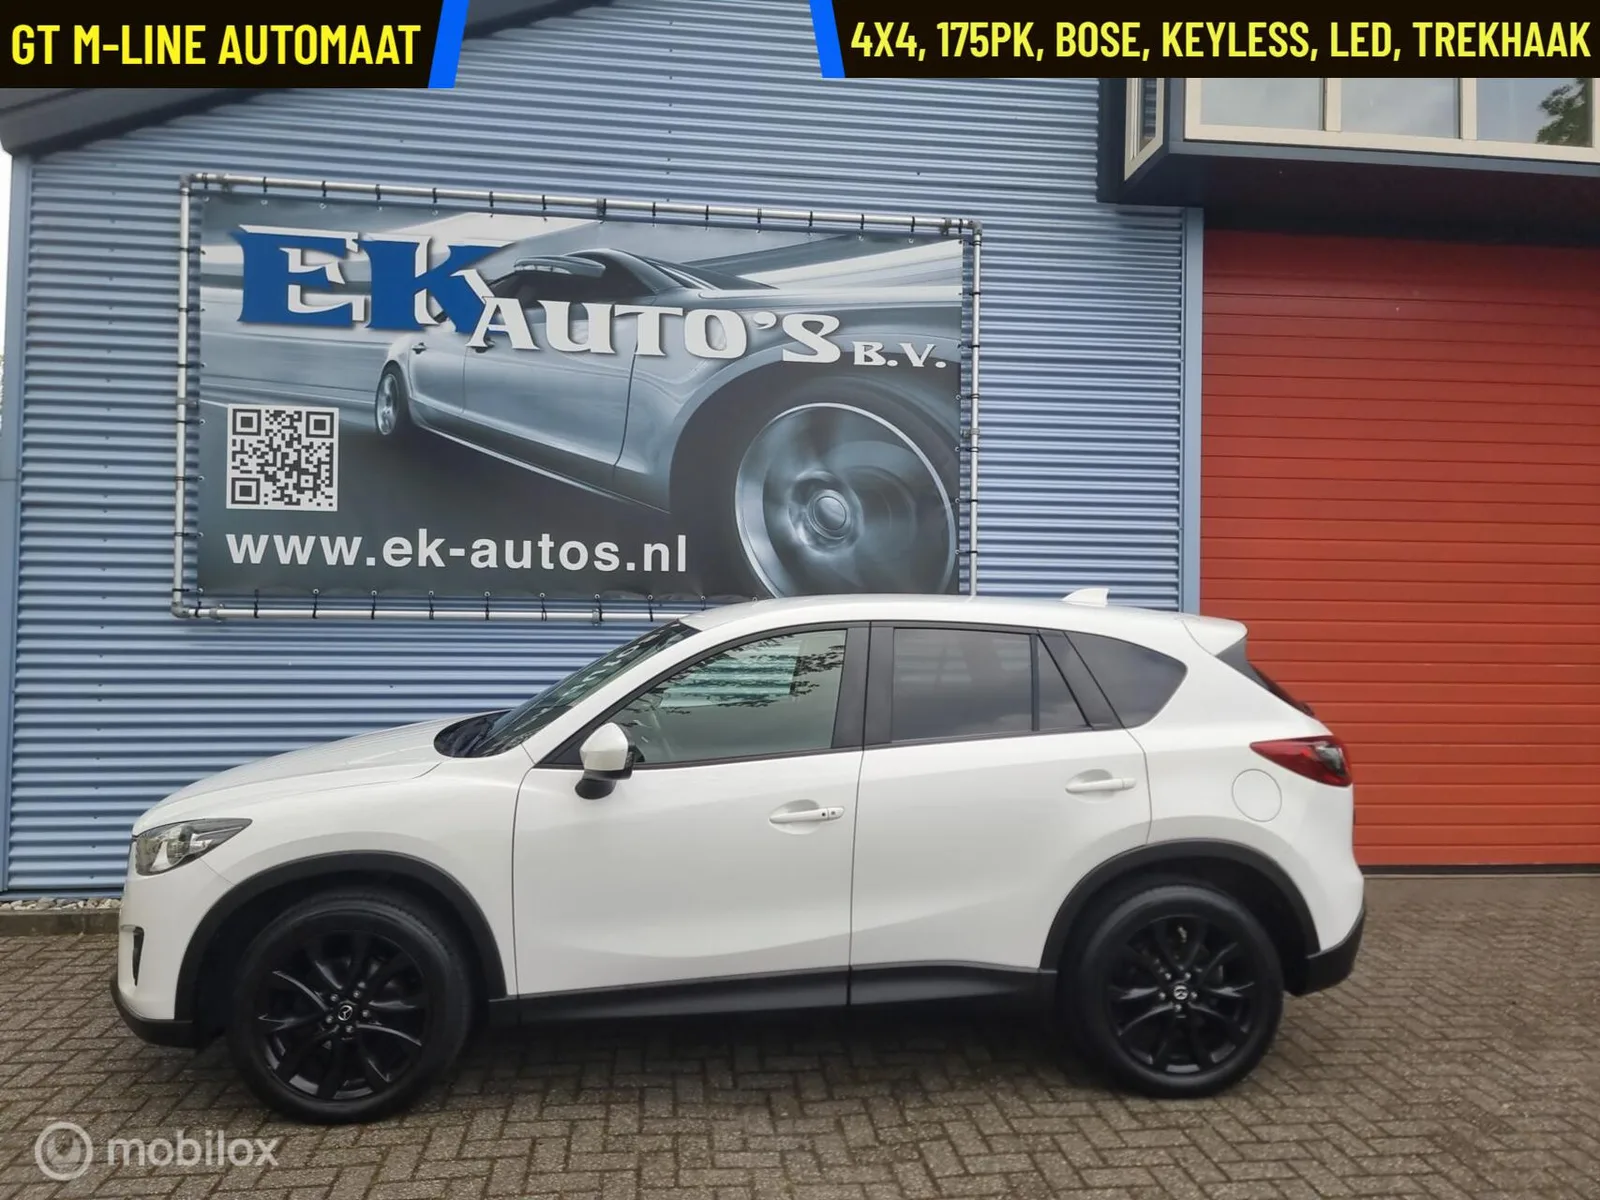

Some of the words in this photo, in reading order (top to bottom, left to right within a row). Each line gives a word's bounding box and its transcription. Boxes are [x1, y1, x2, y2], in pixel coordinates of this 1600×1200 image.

[230, 225, 514, 334] EK
[852, 340, 948, 369] B.V.
[225, 528, 687, 573] www.ek-autos.nl
